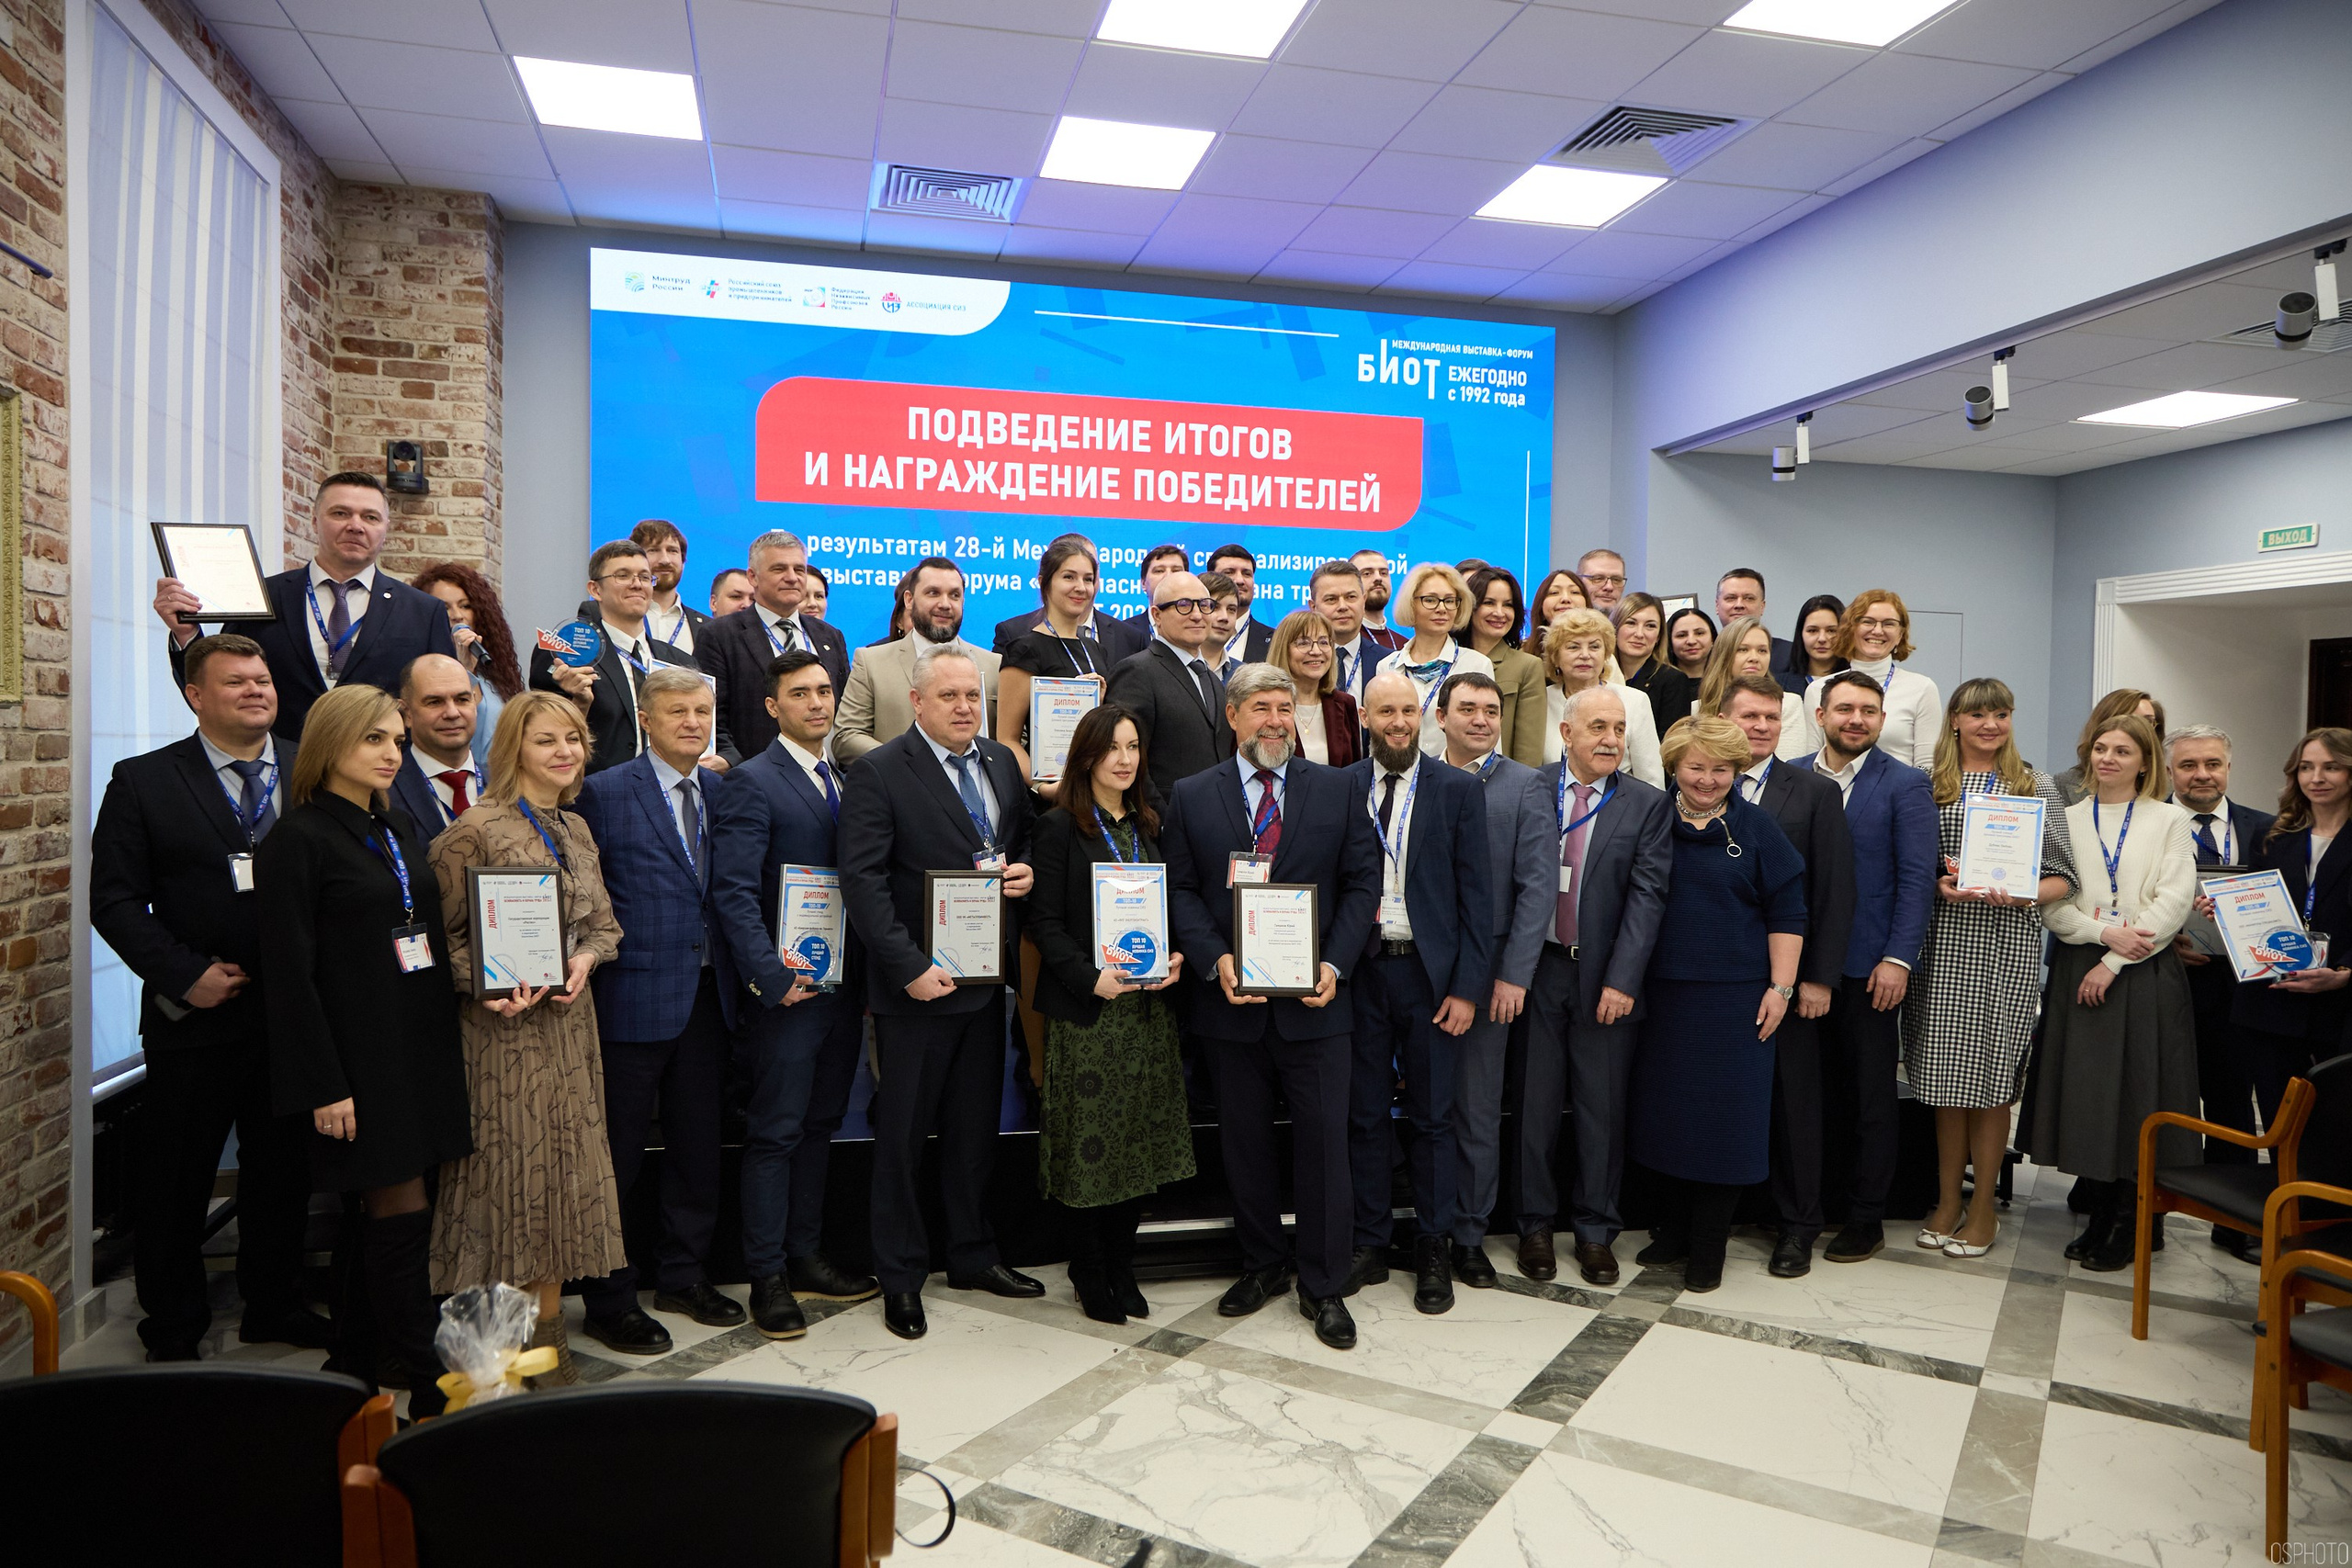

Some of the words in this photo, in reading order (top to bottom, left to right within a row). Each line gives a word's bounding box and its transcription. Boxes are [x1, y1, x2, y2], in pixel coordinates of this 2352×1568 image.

[652, 275, 690, 284] Минтруд
[906, 301, 950, 311] АССОЦИАЦИЯ
[1392, 340, 1461, 354] МЕЖДУНАРОДНАЯ
[1463, 345, 1533, 359] ВЫСТАВКА-ФОРУМ
[1358, 339, 1441, 400] БИОТ
[1448, 366, 1527, 388] ЕЖЕГОДНО
[1448, 388, 1456, 401] с
[1460, 386, 1490, 403] 1992
[1494, 392, 1526, 407] года
[909, 407, 1151, 453] ПОДВЕДЕНИЕ
[1165, 422, 1292, 459] ИТОГОВ
[806, 452, 828, 485] И
[845, 454, 1120, 501] НАГРАЖДЕНИЕ
[1135, 469, 1380, 513] ПОБЕДИТЕЛЕЙ
[808, 535, 946, 558] результатам
[955, 536, 1005, 559] 28-й
[2268, 529, 2307, 545] ВЫХОД
[541, 630, 571, 652] БИОТ
[1988, 814, 2019, 822] ДИПЛОМ
[803, 891, 829, 899] ДИПЛОМ
[2235, 892, 2265, 904] ДИПЛОМ
[488, 899, 498, 929] ДИПЛОМ
[786, 945, 810, 968] БИОТ
[1106, 942, 1133, 963] БИОТ
[2255, 942, 2287, 962] БИОТ
